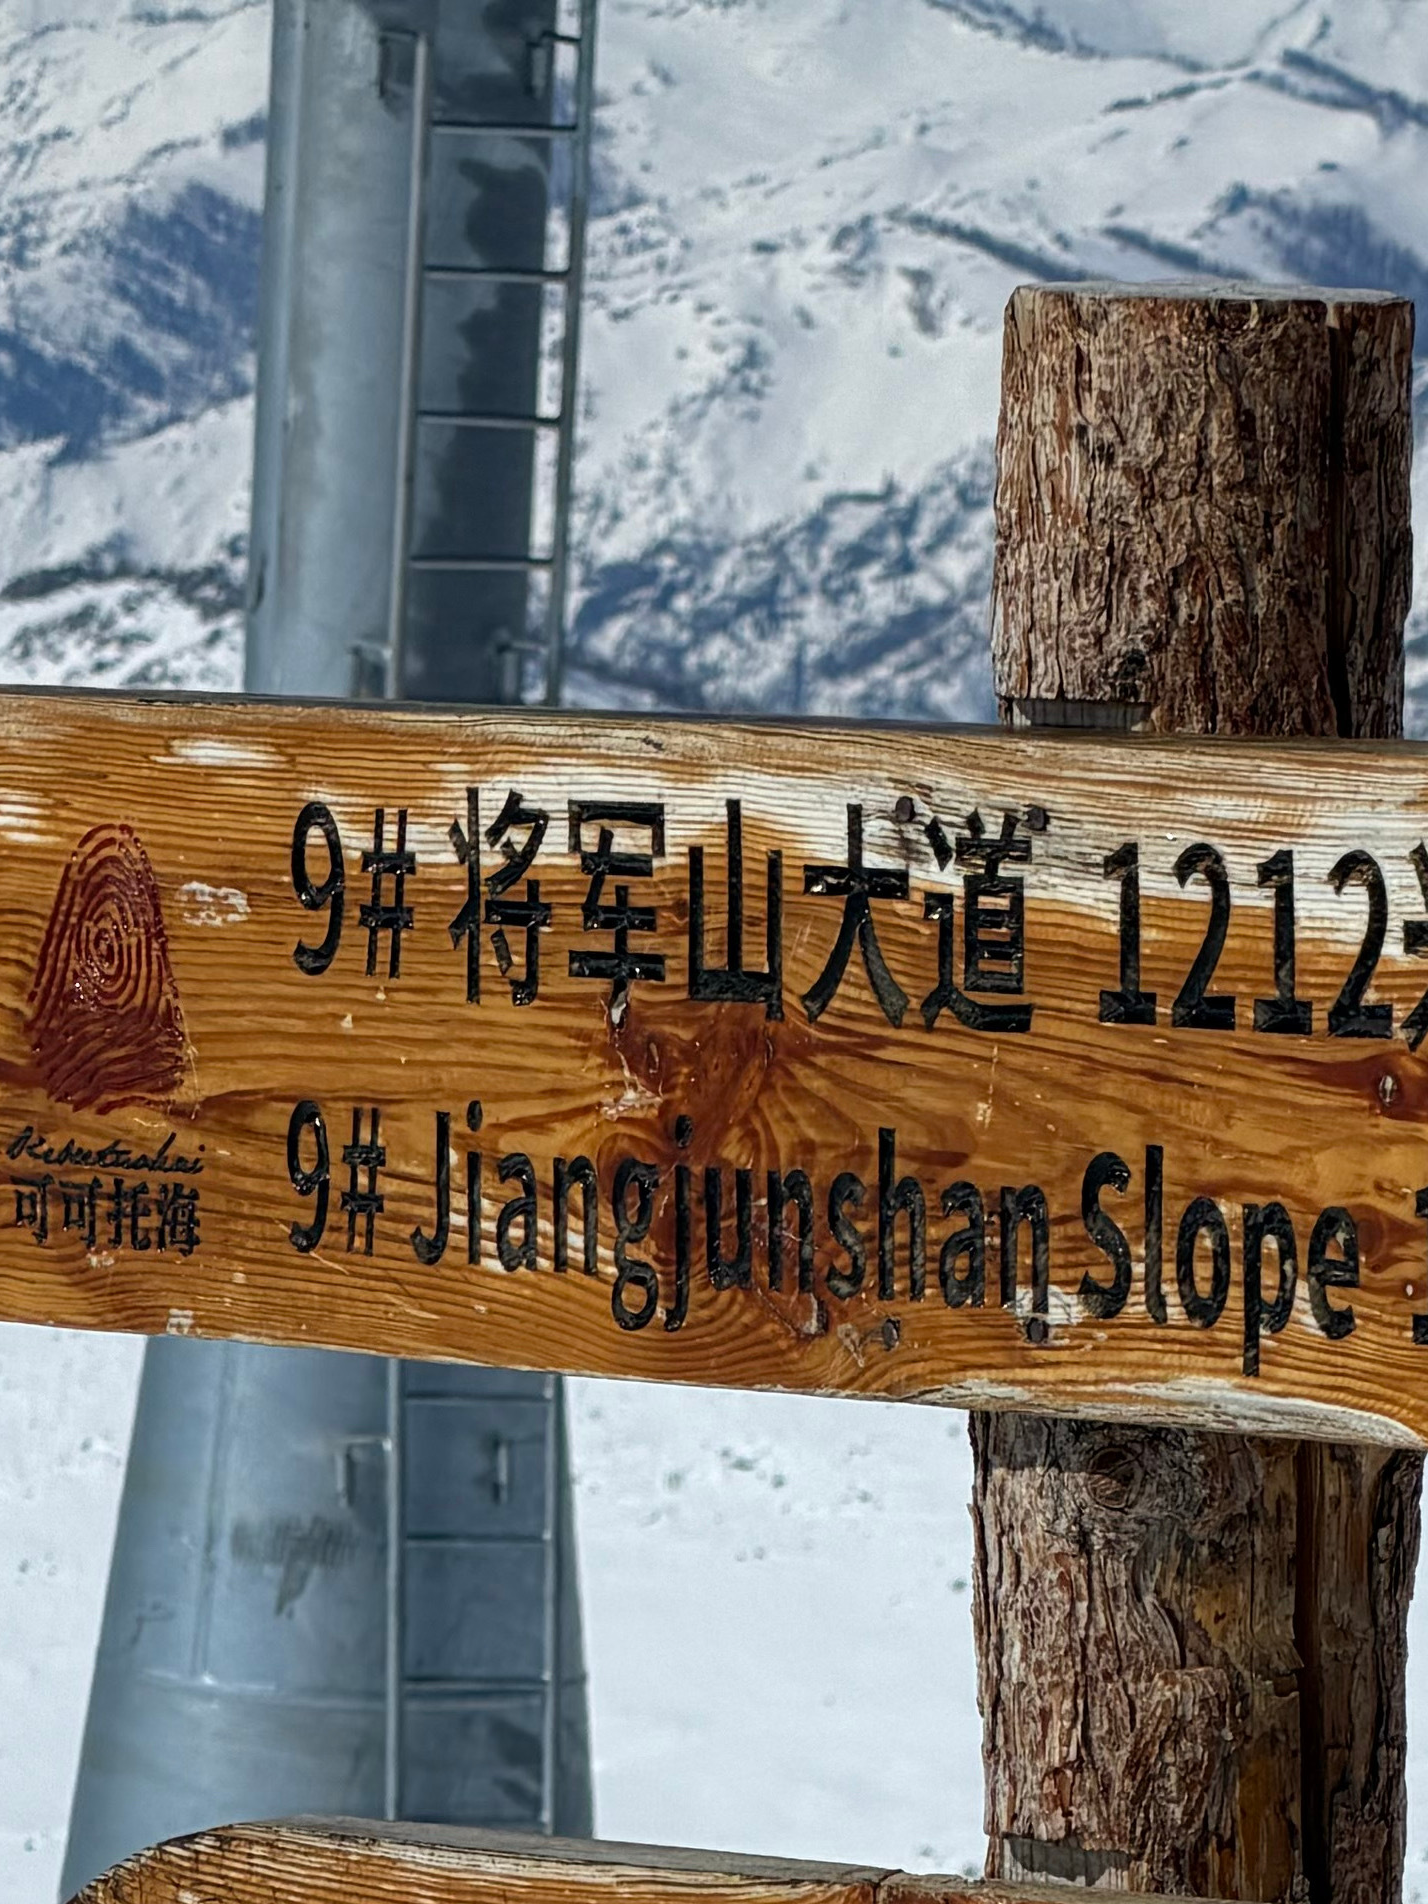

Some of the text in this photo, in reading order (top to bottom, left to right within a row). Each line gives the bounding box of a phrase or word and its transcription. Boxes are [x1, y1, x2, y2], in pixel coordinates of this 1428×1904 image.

[290, 802, 416, 978] 9#
[449, 788, 1035, 1034] 将军山大道
[10, 1173, 201, 1257] 可可托海
[287, 1099, 386, 1256] 9#
[410, 1101, 1050, 1332] Jiangjunshan
[1078, 1146, 1360, 1376] Slope
